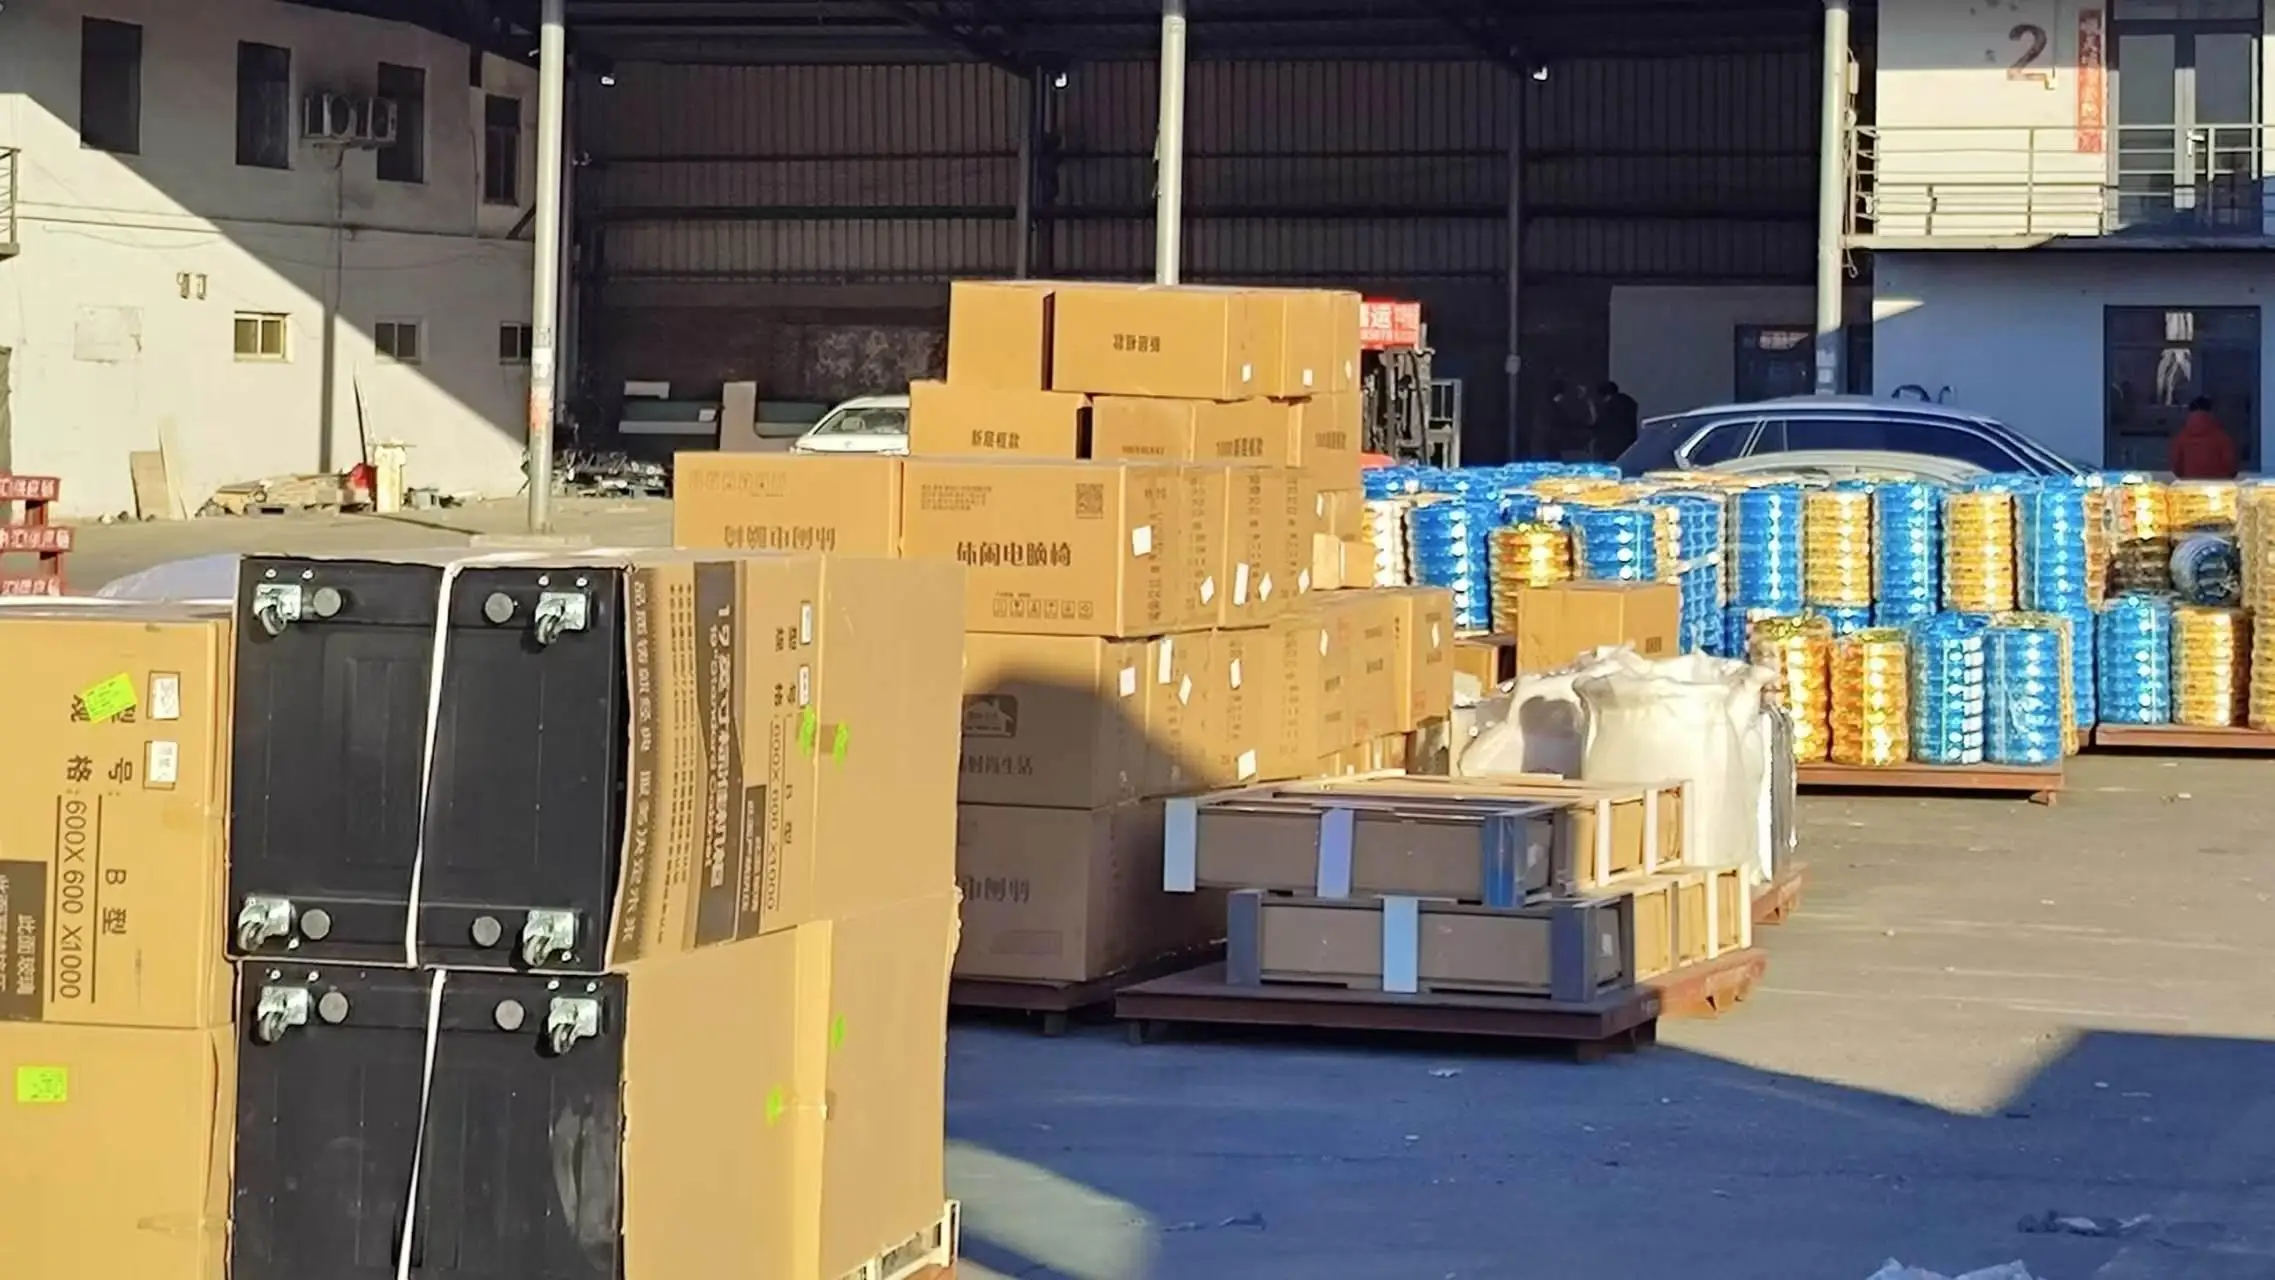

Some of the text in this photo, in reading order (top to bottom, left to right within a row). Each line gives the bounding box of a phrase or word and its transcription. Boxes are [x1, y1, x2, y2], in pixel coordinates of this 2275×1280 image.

[2006, 24, 2048, 81] 2
[956, 541, 1072, 567] 休闲电脑椅
